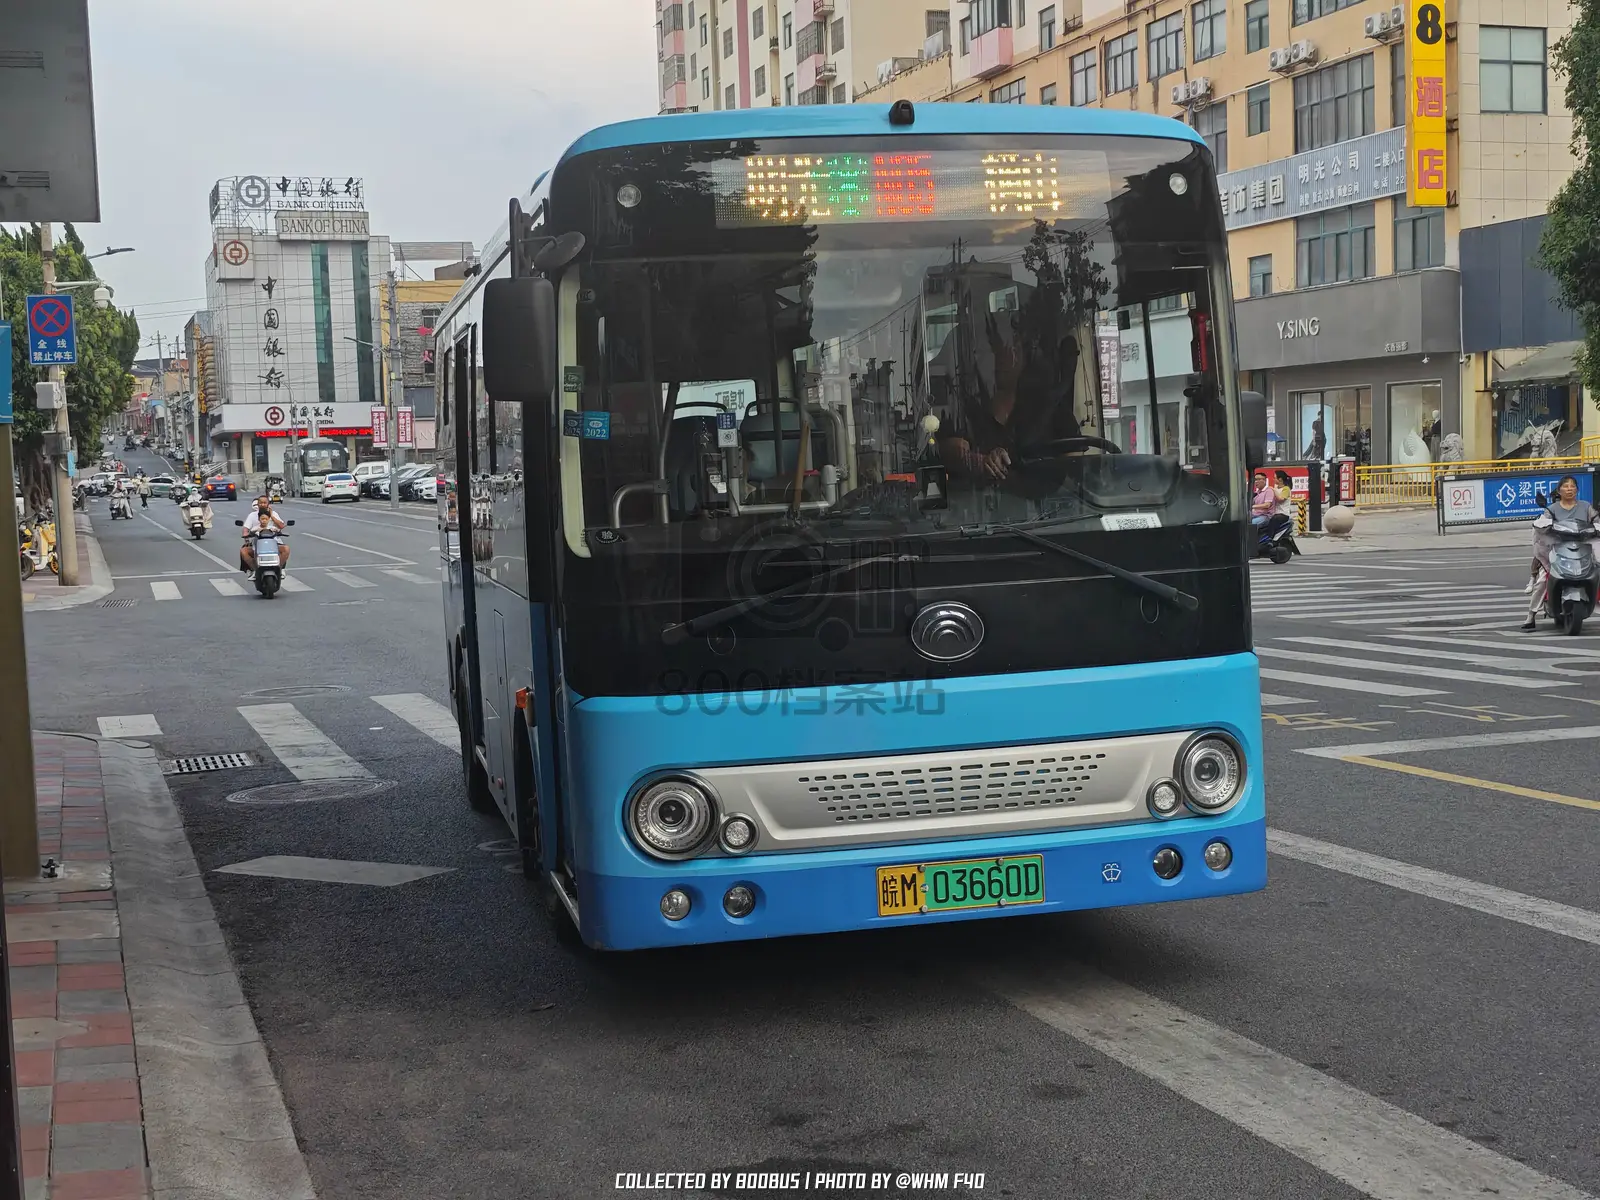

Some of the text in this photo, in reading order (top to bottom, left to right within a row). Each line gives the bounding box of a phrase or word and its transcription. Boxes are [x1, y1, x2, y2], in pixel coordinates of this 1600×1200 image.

[1299, 151, 1359, 184] 明光公司
[277, 200, 364, 209] BANK OF CHINA
[281, 219, 367, 234] BANK OF CHINA
[1277, 317, 1320, 339] Y.SING
[33, 351, 73, 361] 禁止停车
[585, 428, 607, 438] 2022
